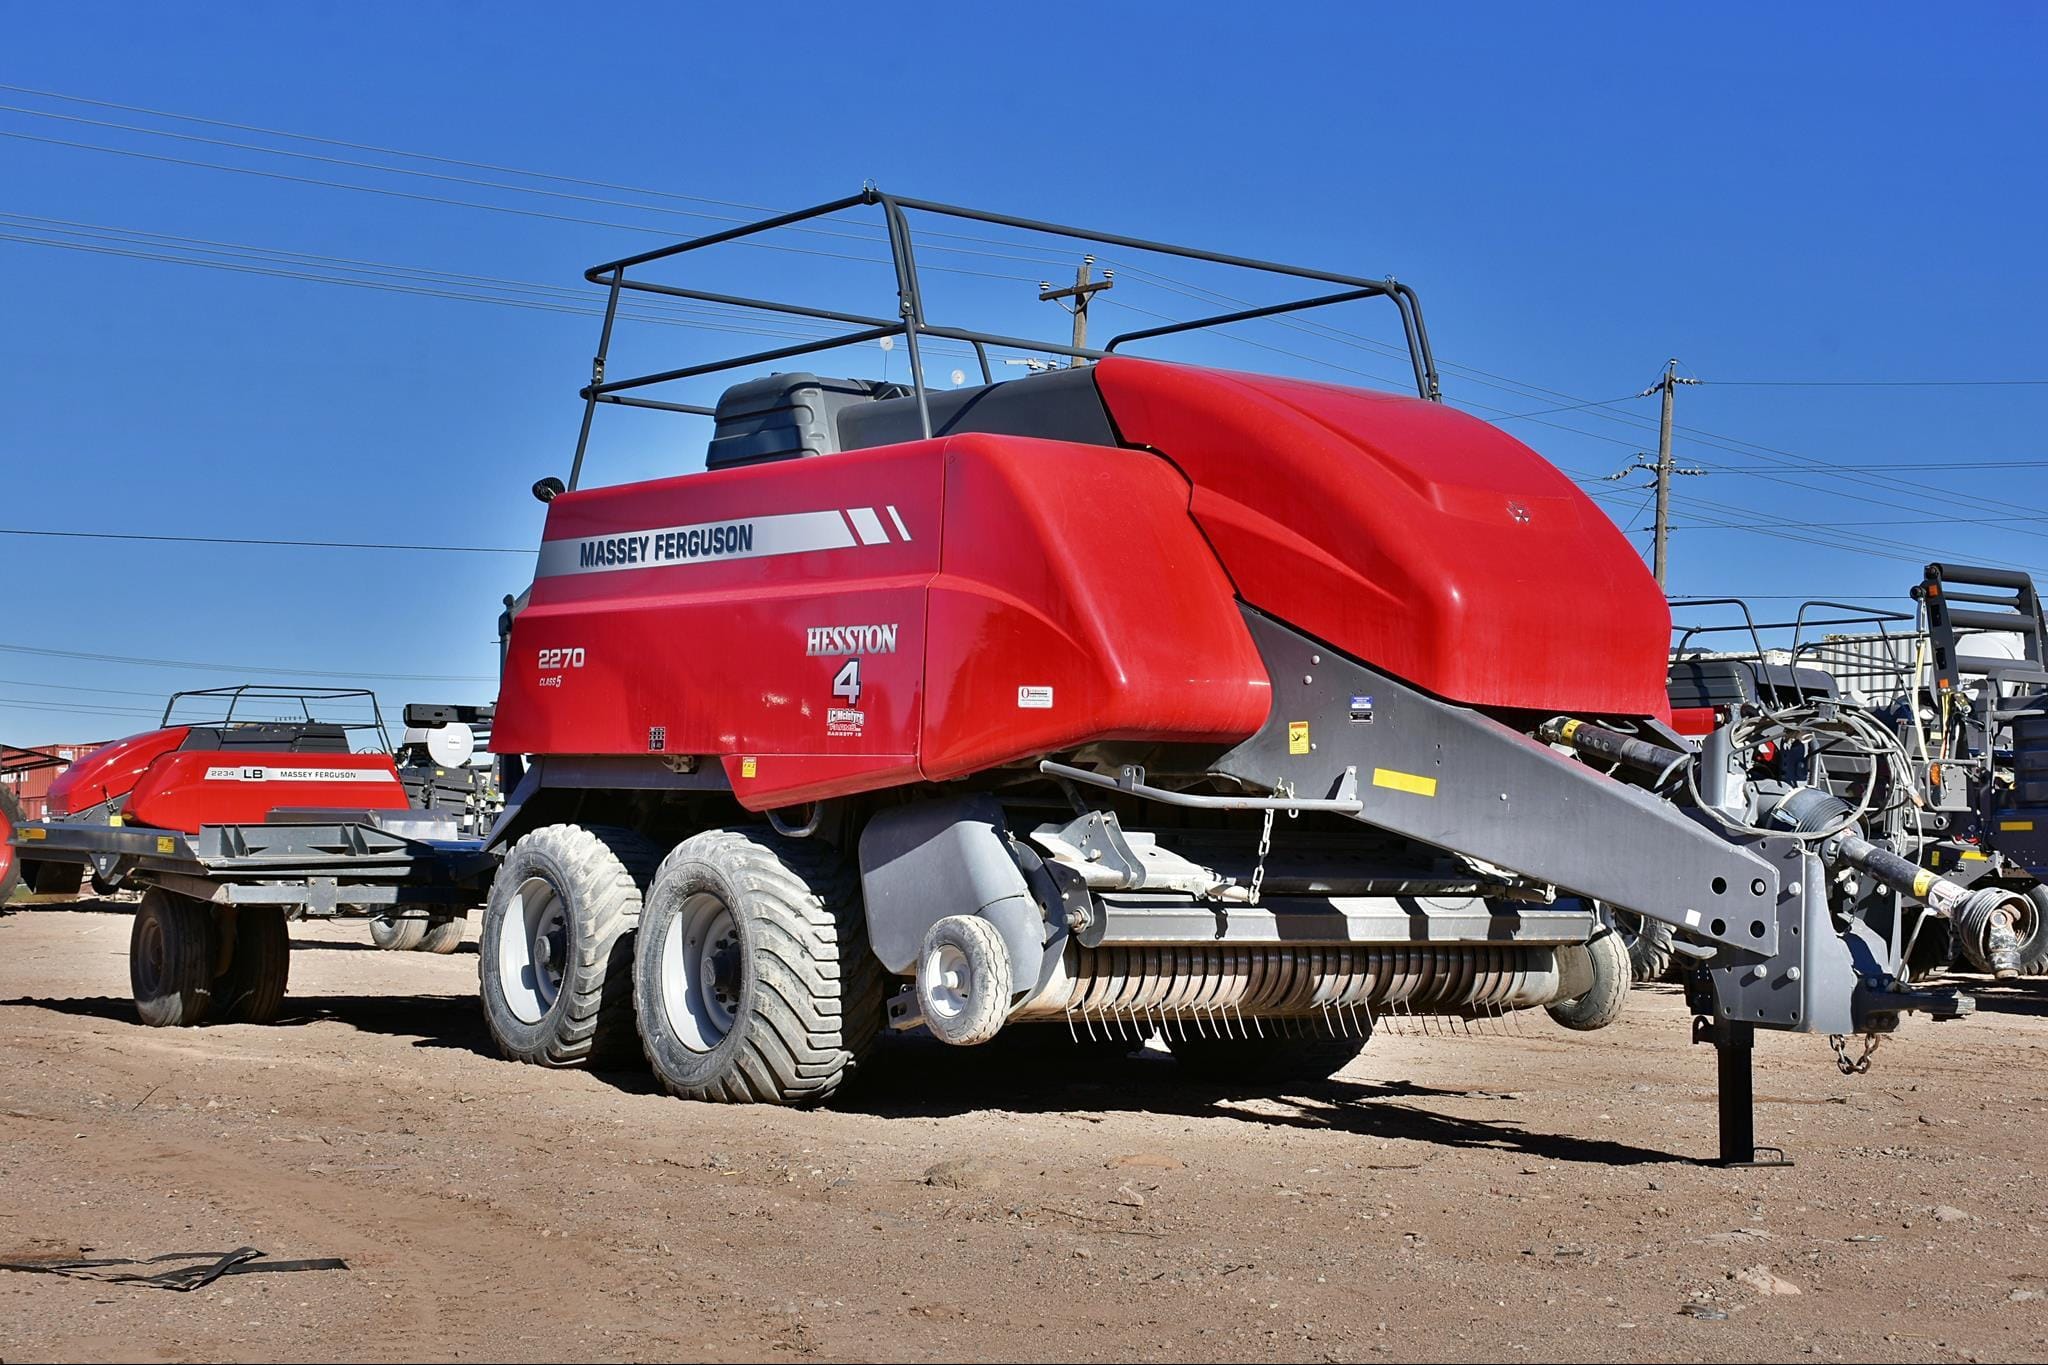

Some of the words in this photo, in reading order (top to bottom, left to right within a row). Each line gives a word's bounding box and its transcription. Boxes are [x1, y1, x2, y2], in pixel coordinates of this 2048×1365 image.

[579, 535, 650, 568] MASSEY
[654, 523, 753, 561] FERGUSON
[806, 623, 899, 656] HESSTON
[538, 647, 585, 669] 2270
[832, 658, 862, 707] 4
[243, 769, 263, 779] LB
[314, 771, 356, 779] FERGUSON
